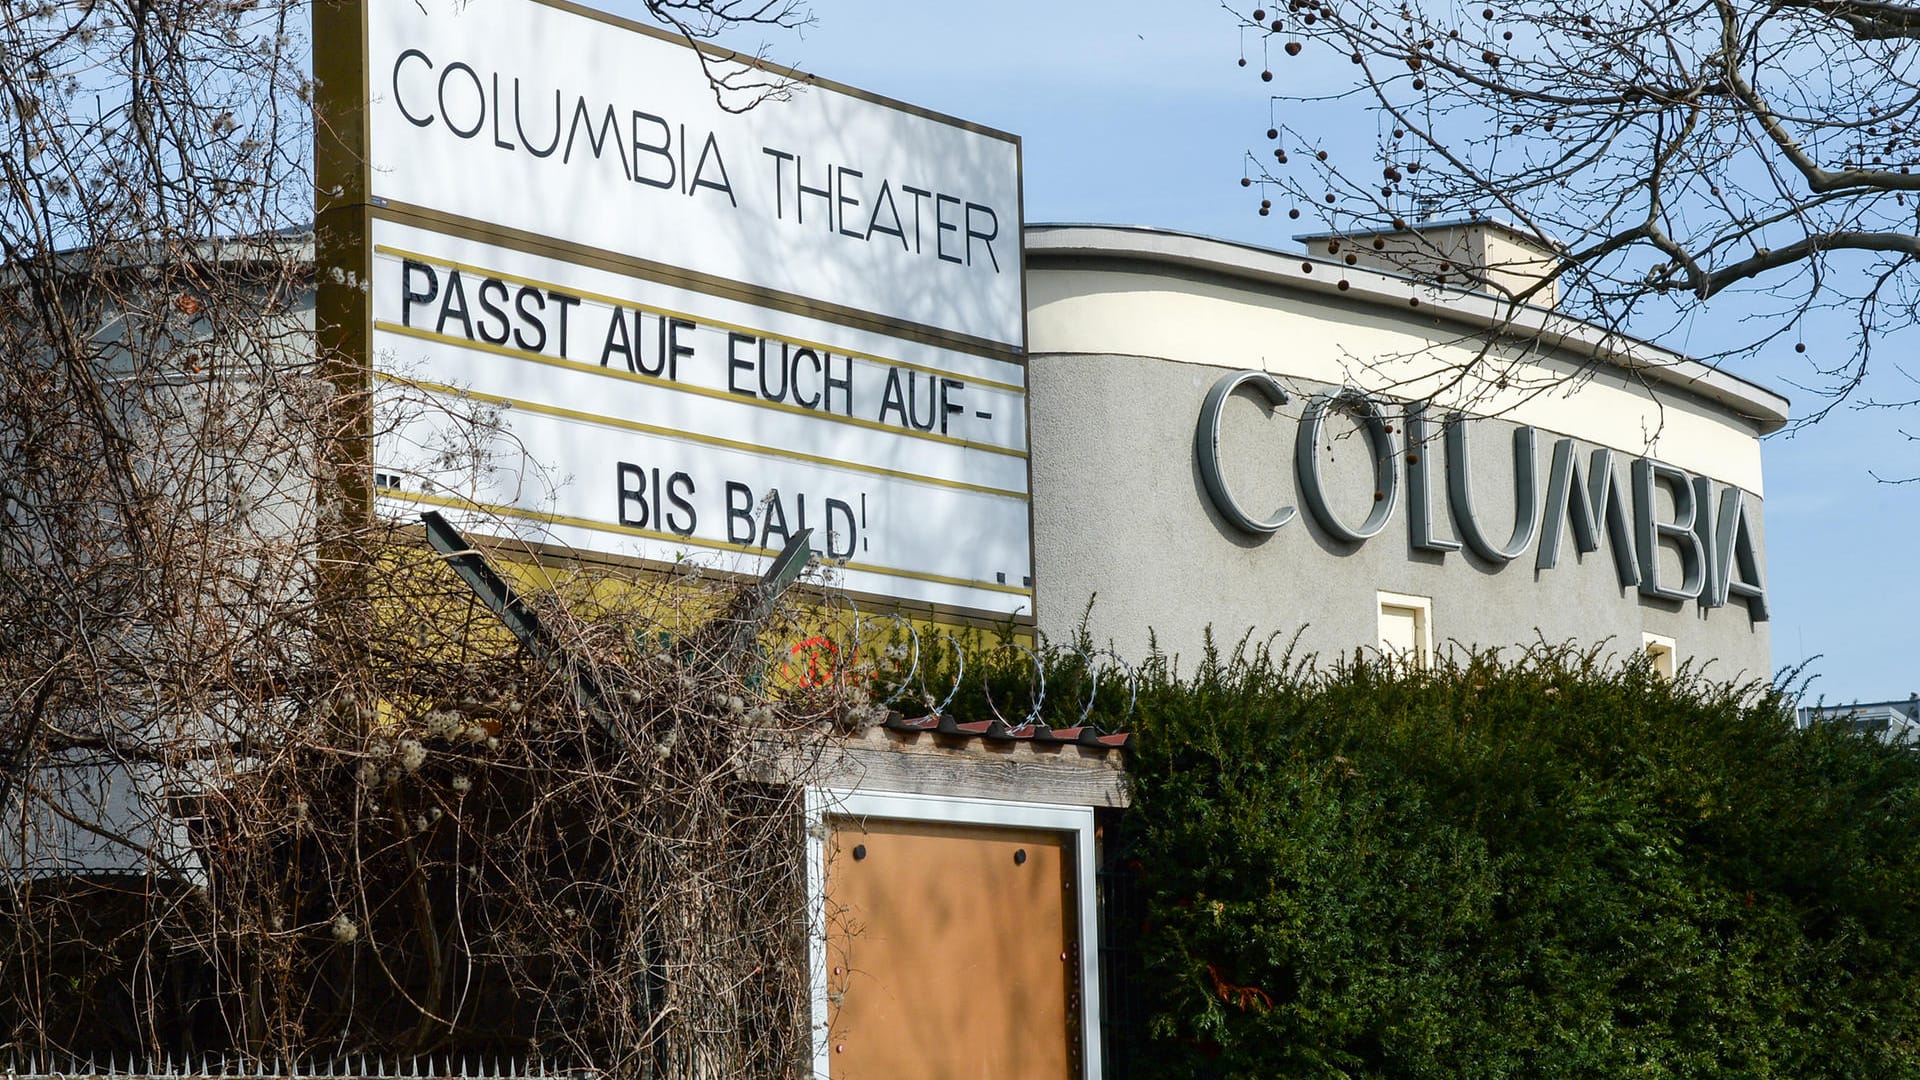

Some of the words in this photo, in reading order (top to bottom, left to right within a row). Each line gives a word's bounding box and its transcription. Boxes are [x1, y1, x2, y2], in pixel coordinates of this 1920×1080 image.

[393, 49, 737, 208] COLUMBIA
[763, 147, 1000, 274] THEATER
[401, 259, 581, 359] PASST
[601, 306, 696, 381] AUF
[728, 332, 853, 418] EUCH
[617, 461, 697, 536] BIS
[725, 480, 868, 560] BALD!
[1197, 369, 1770, 622] COLUMBIA
